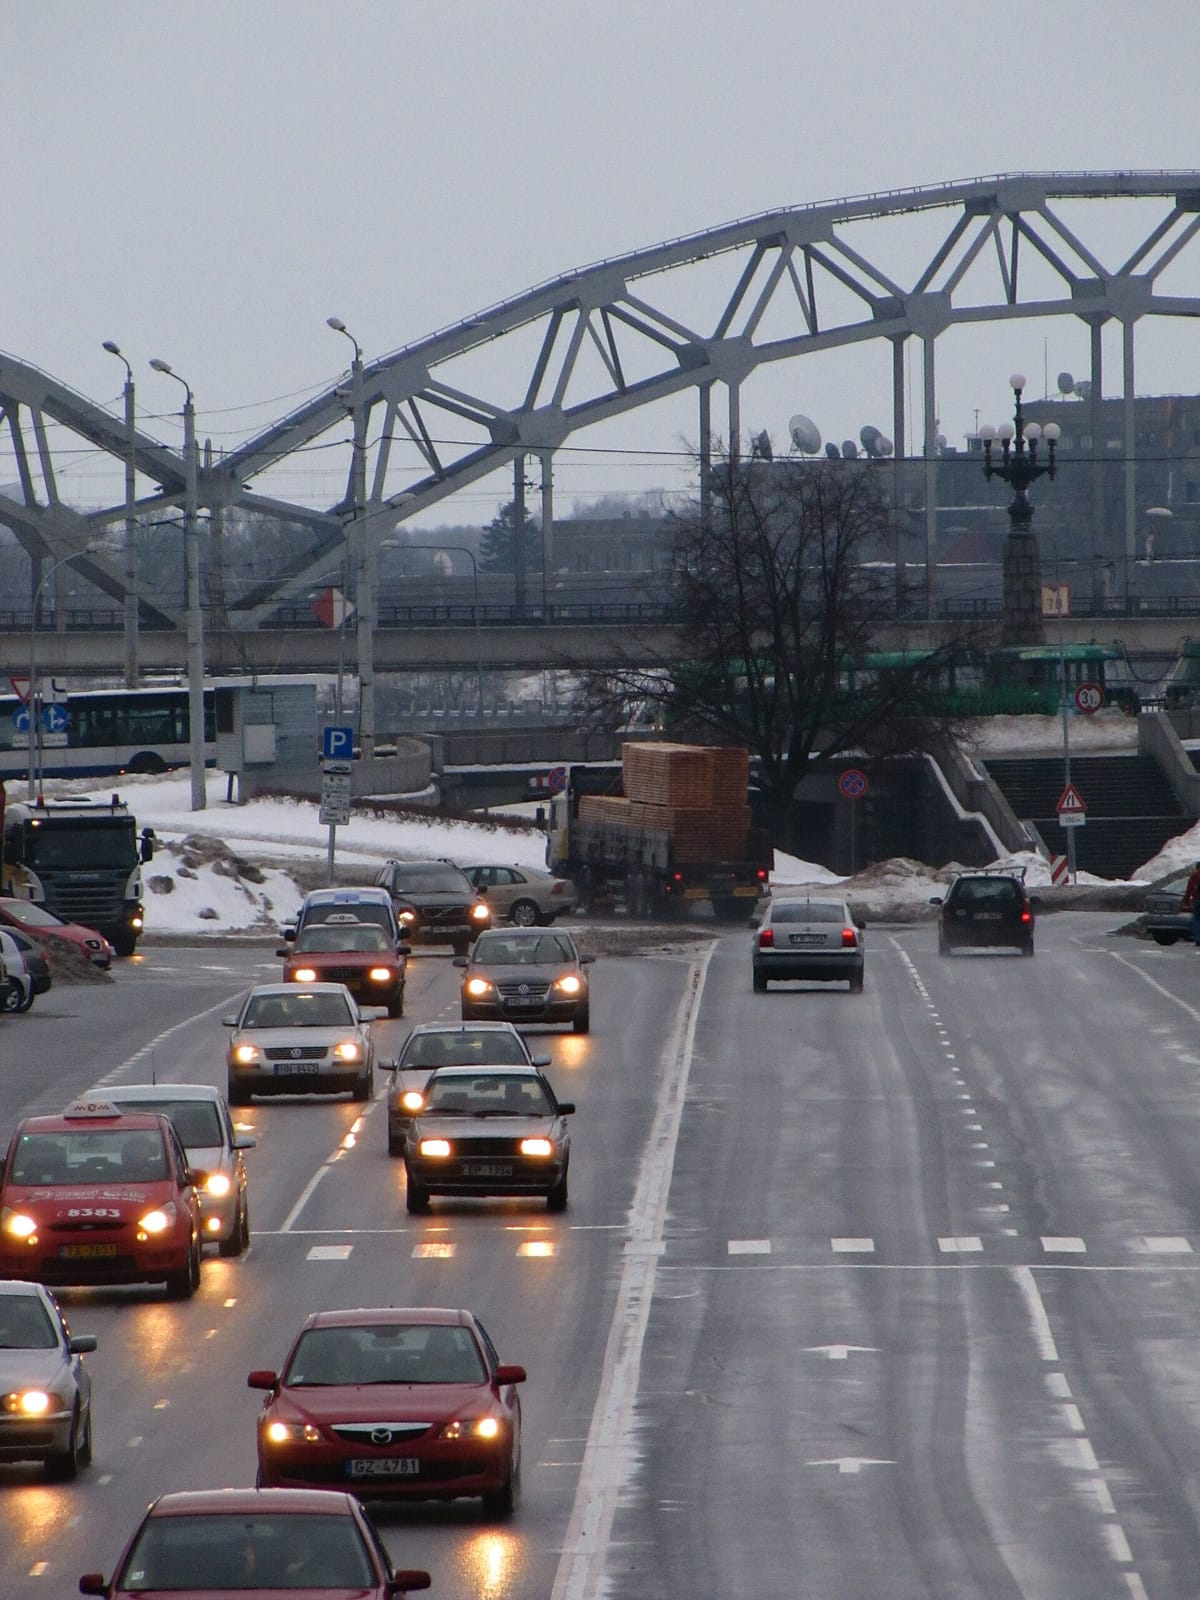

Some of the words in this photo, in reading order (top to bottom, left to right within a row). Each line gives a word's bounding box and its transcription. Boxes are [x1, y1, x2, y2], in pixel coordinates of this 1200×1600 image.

[330, 731, 347, 755] P
[67, 1207, 121, 1218] 8383
[354, 1460, 417, 1473] GZ-4781
